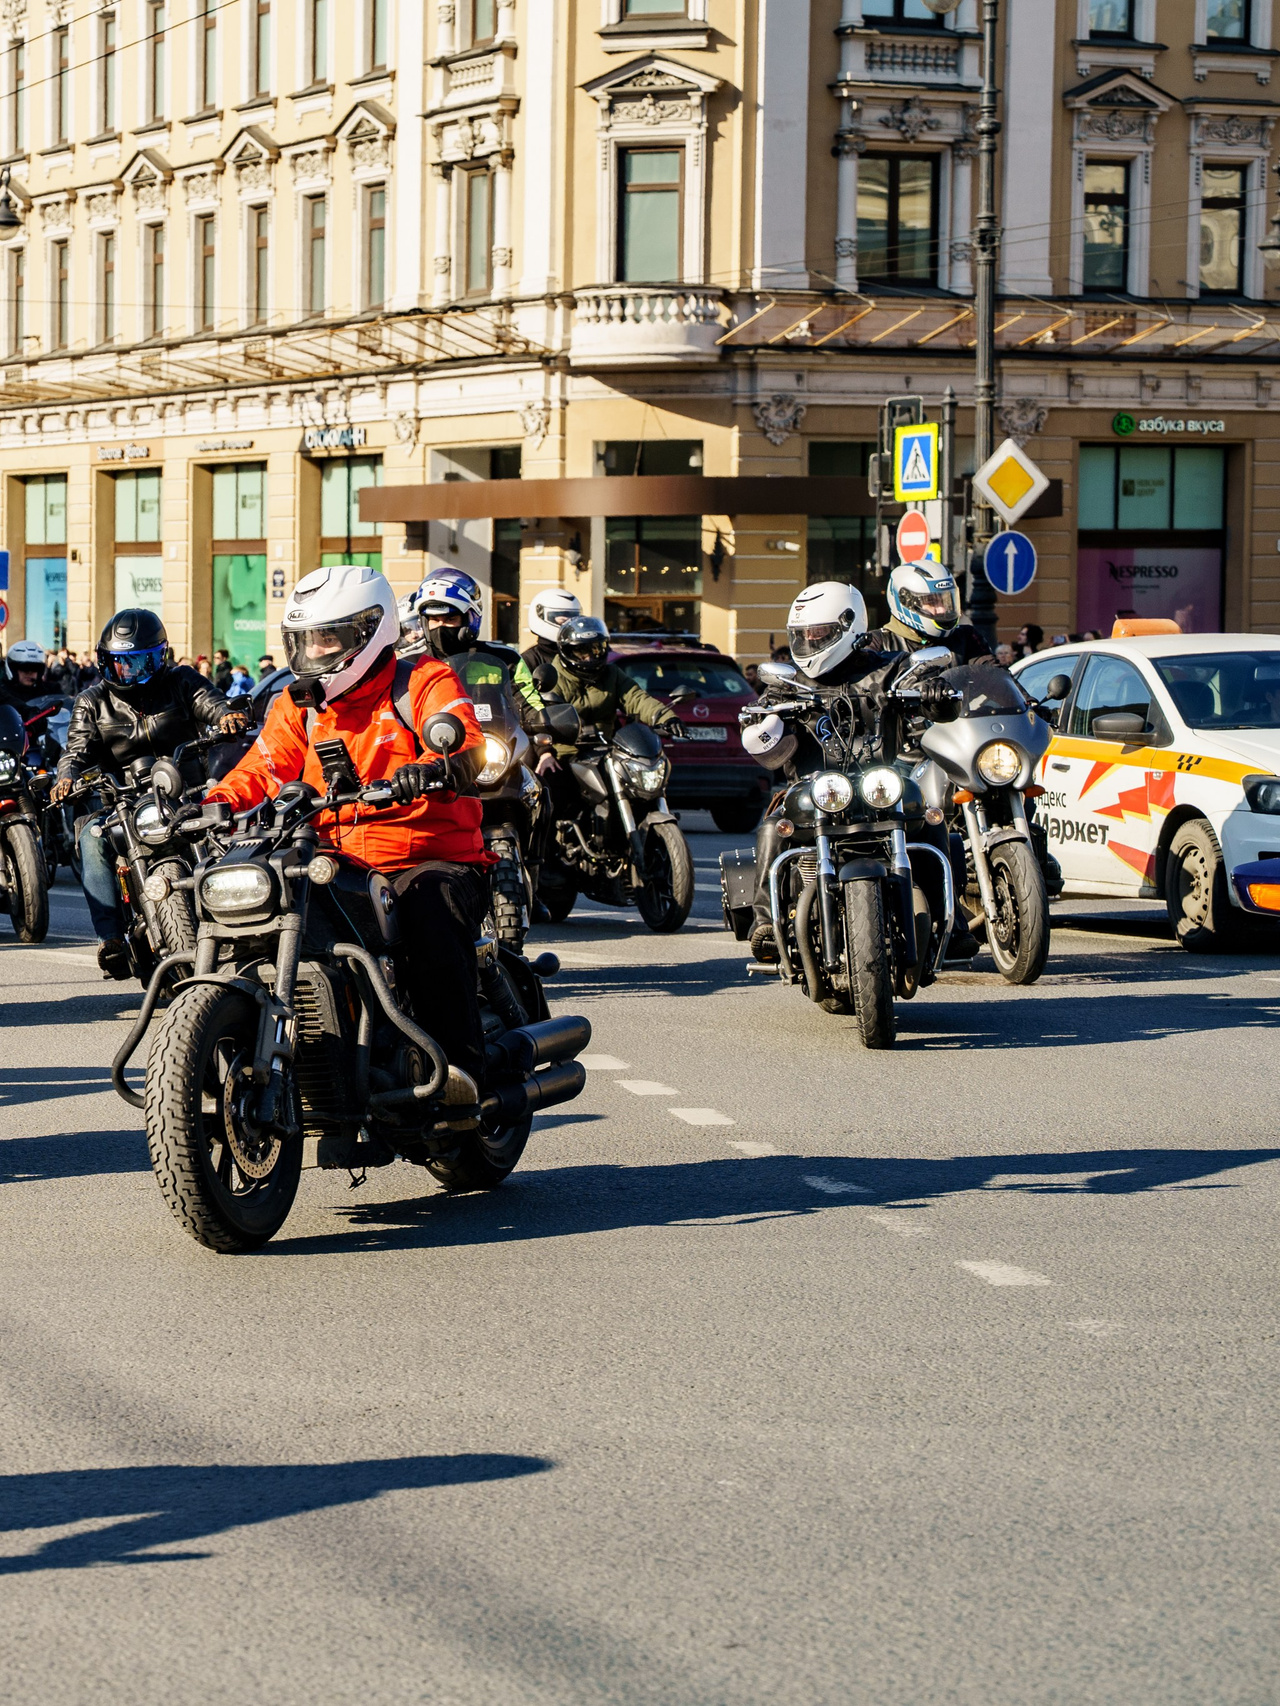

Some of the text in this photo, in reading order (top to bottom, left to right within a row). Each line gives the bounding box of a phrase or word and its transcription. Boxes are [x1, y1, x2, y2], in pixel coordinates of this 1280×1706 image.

[1139, 416, 1225, 434] азбука вкуса
[1106, 560, 1179, 583] NESPRESSO
[762, 736, 779, 751] REPUS
[1034, 791, 1067, 810] ндекс
